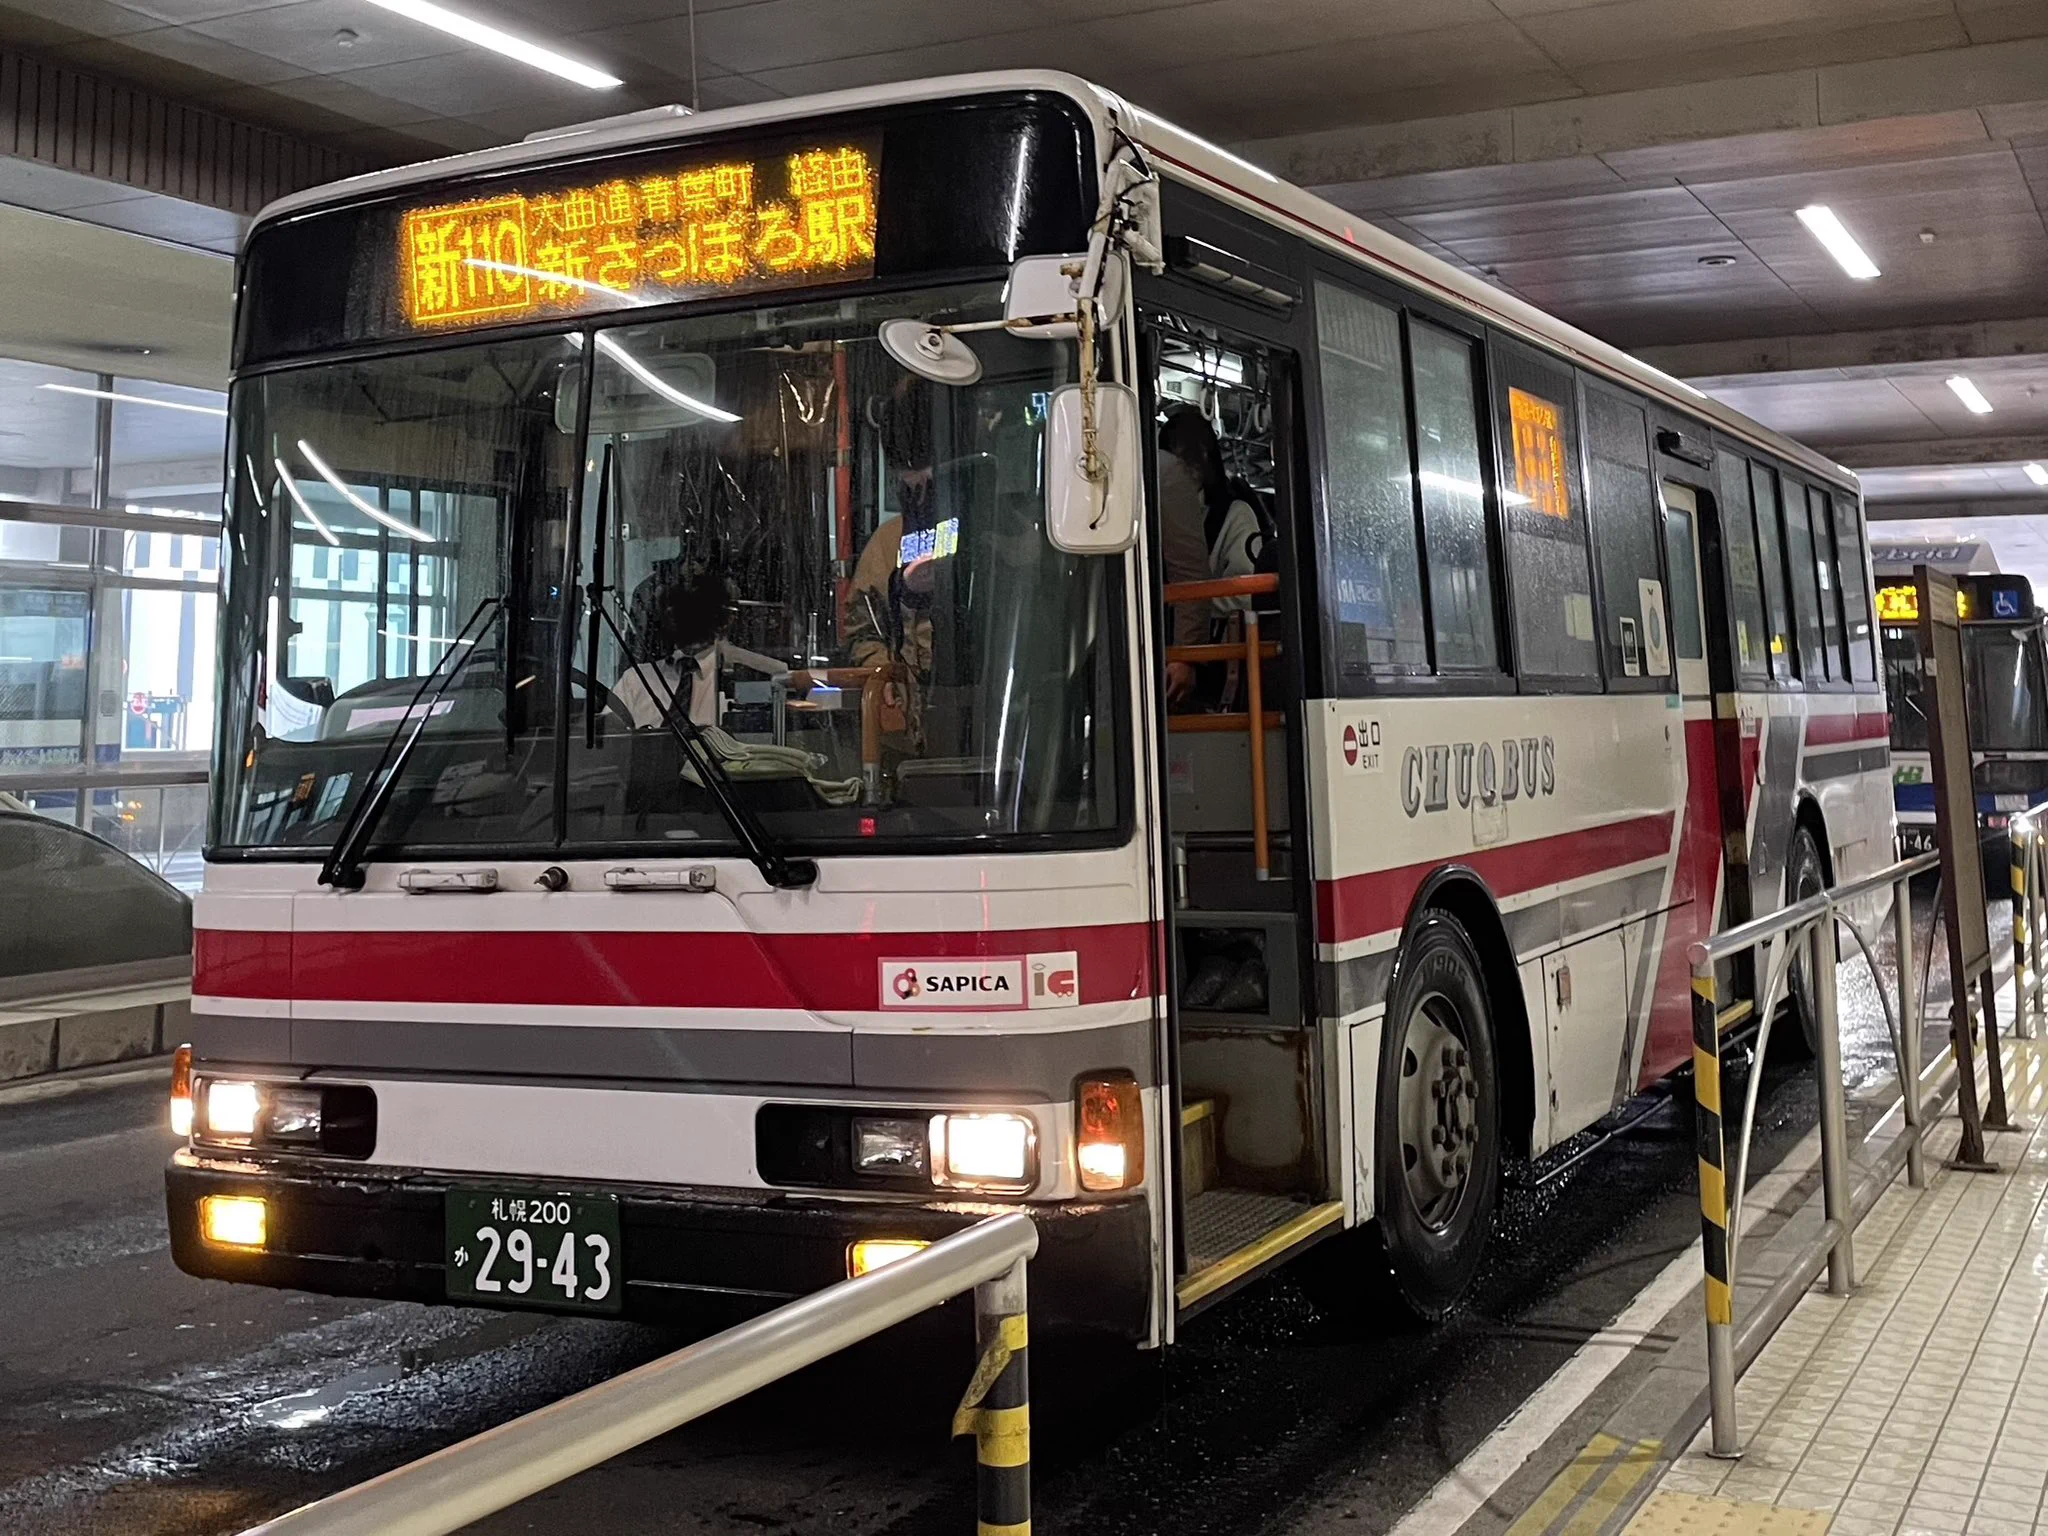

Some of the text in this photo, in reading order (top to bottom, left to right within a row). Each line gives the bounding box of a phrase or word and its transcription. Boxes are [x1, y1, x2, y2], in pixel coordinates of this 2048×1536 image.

[790, 149, 866, 197] 経由
[417, 218, 524, 312] 新110
[535, 195, 876, 299] 新さっぽろ駅
[1872, 547, 1961, 562] ybrid
[1358, 719, 1380, 747] 出口
[1362, 753, 1379, 769] EXIT
[1501, 735, 1556, 801] BUS
[926, 975, 1010, 993] SAPICA
[454, 1226, 611, 1301] か 29-43
